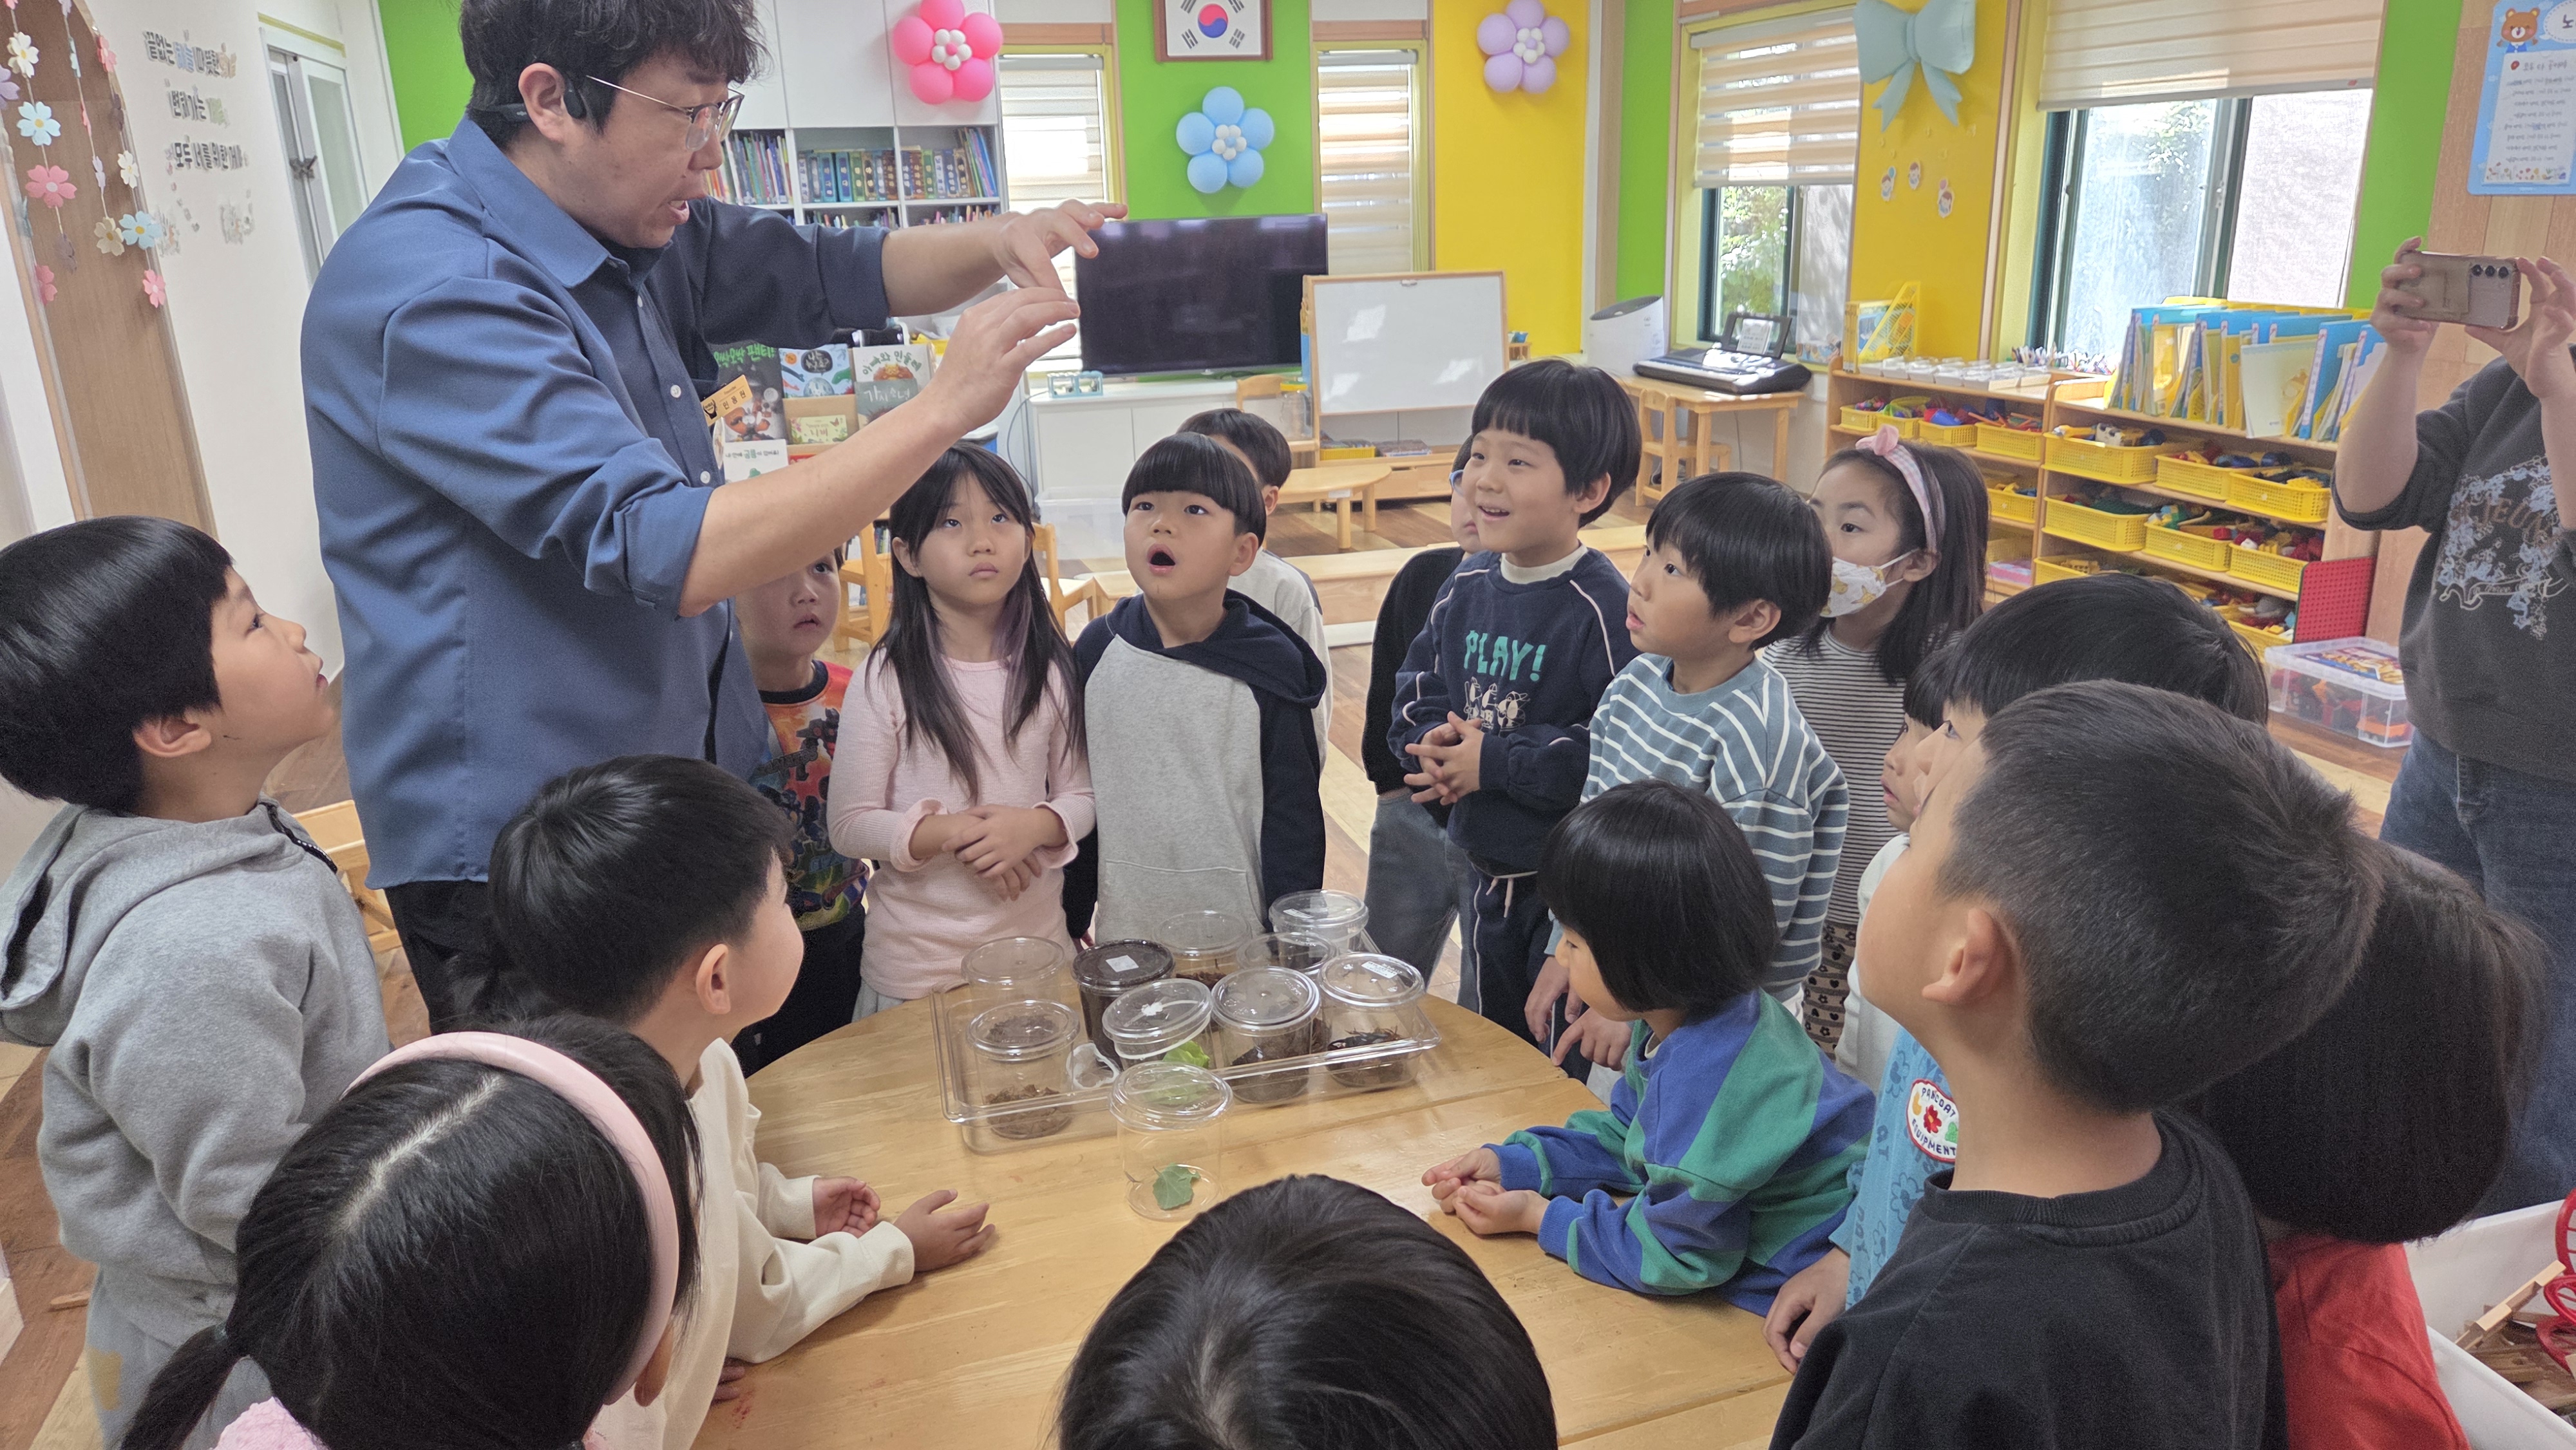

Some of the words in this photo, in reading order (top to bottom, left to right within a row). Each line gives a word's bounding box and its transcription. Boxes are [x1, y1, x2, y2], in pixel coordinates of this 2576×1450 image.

[174, 142, 193, 169] 모두
[864, 385, 888, 402] 가시
[1463, 630, 1546, 682] PLAY!
[1921, 1087, 1956, 1118] PANCOAT
[1911, 1118, 1956, 1156] EQUIPMENT
